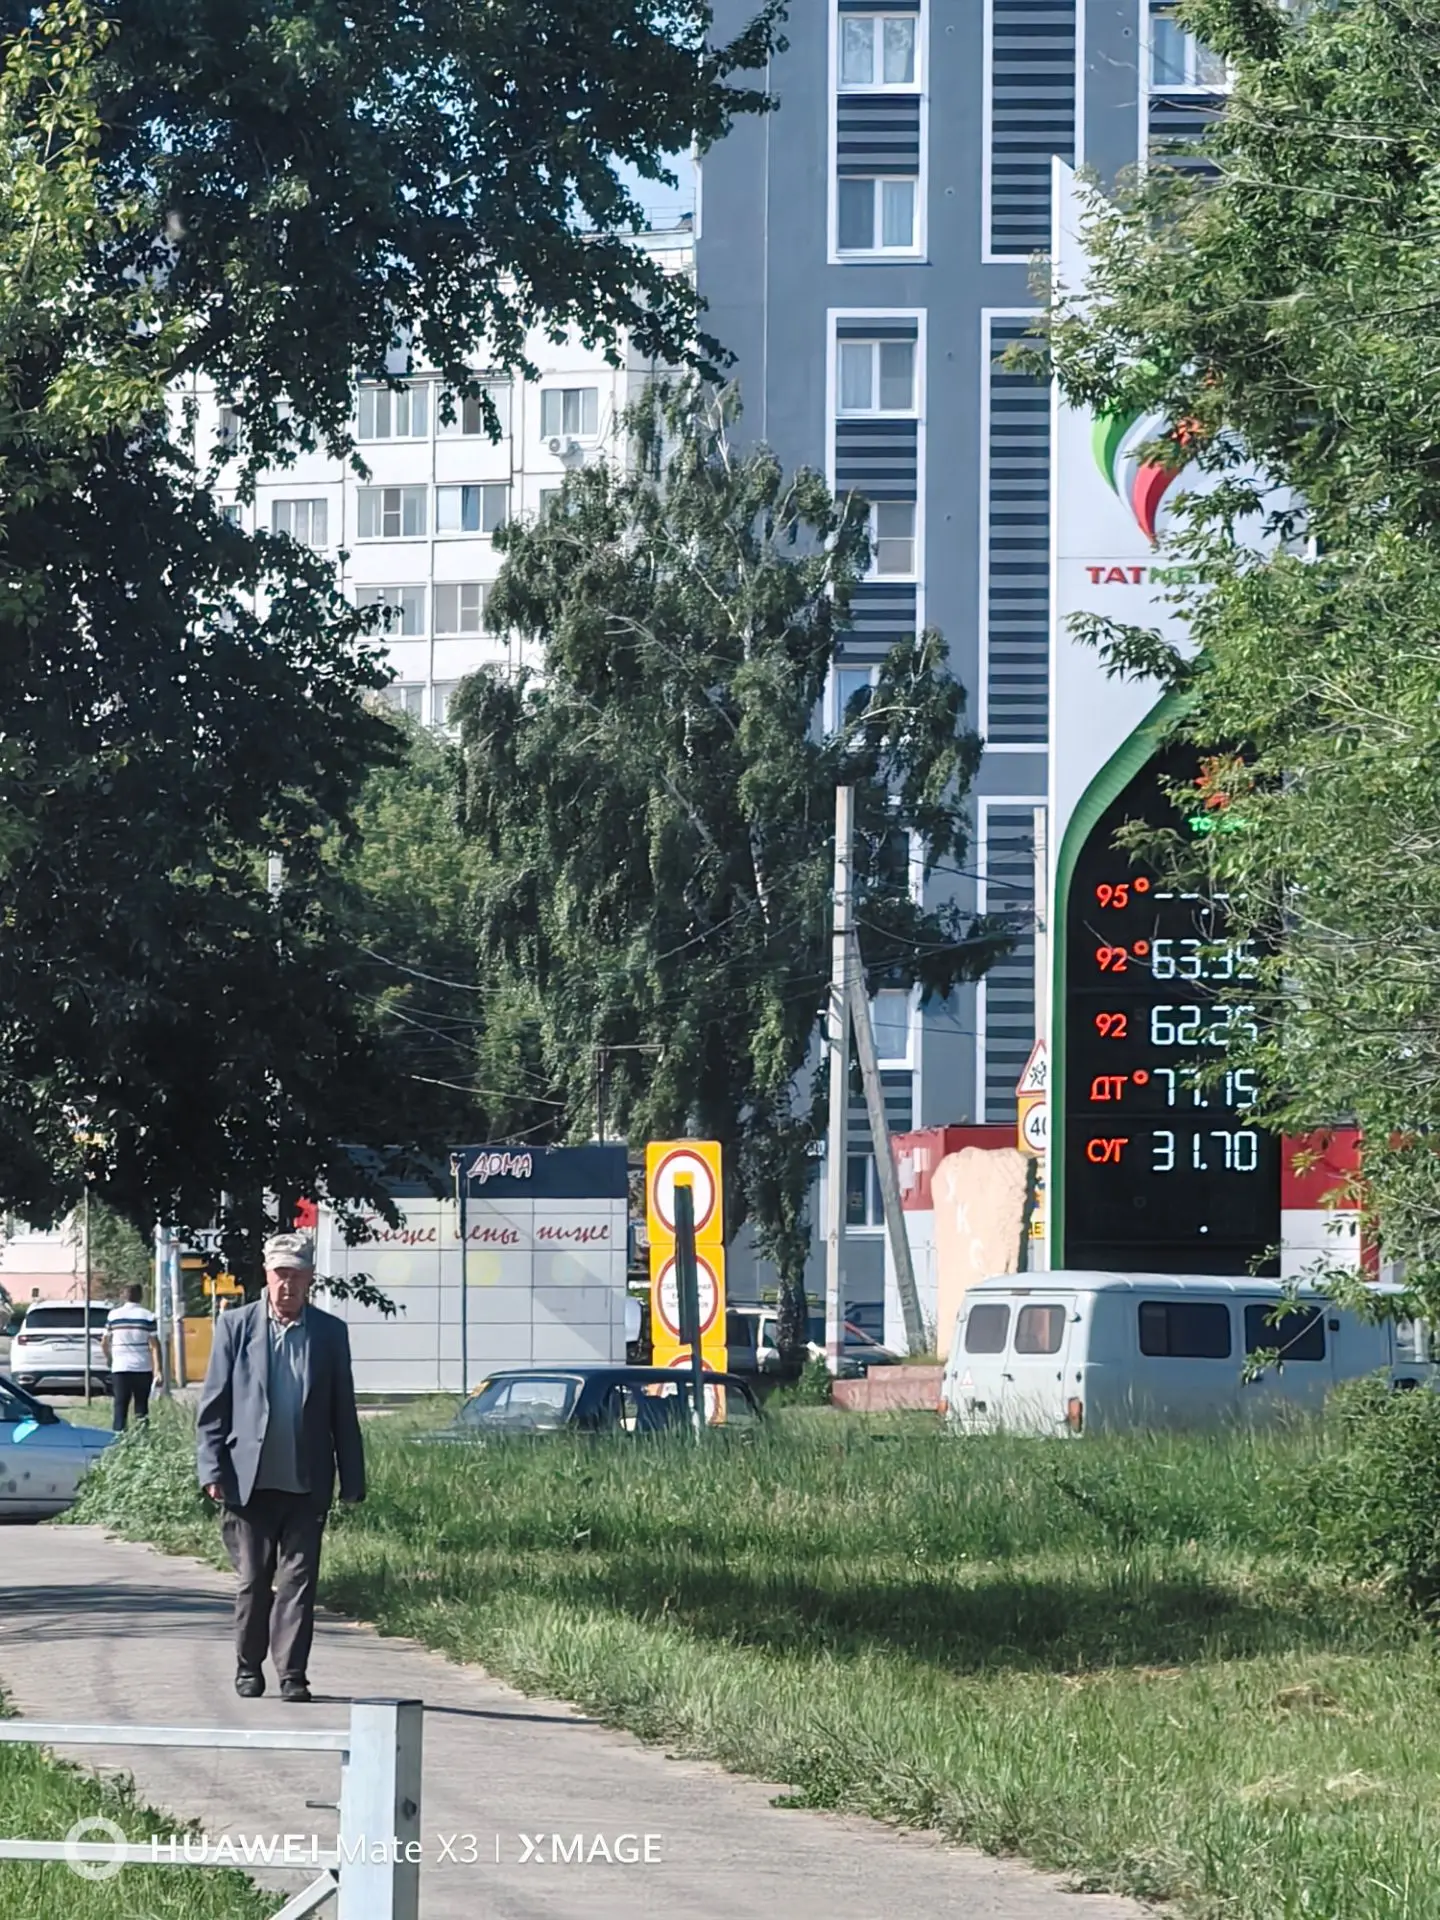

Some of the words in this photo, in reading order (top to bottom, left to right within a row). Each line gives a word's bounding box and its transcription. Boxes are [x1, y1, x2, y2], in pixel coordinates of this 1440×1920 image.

[1151, 939, 1259, 980] 63.35
[1095, 1012, 1128, 1038] 92
[1152, 1068, 1258, 1108] 77.15
[466, 1152, 533, 1185] ДОМА
[1086, 1138, 1129, 1163] СУГ
[1151, 1131, 1258, 1171] 31.70
[535, 1224, 611, 1245] ниже
